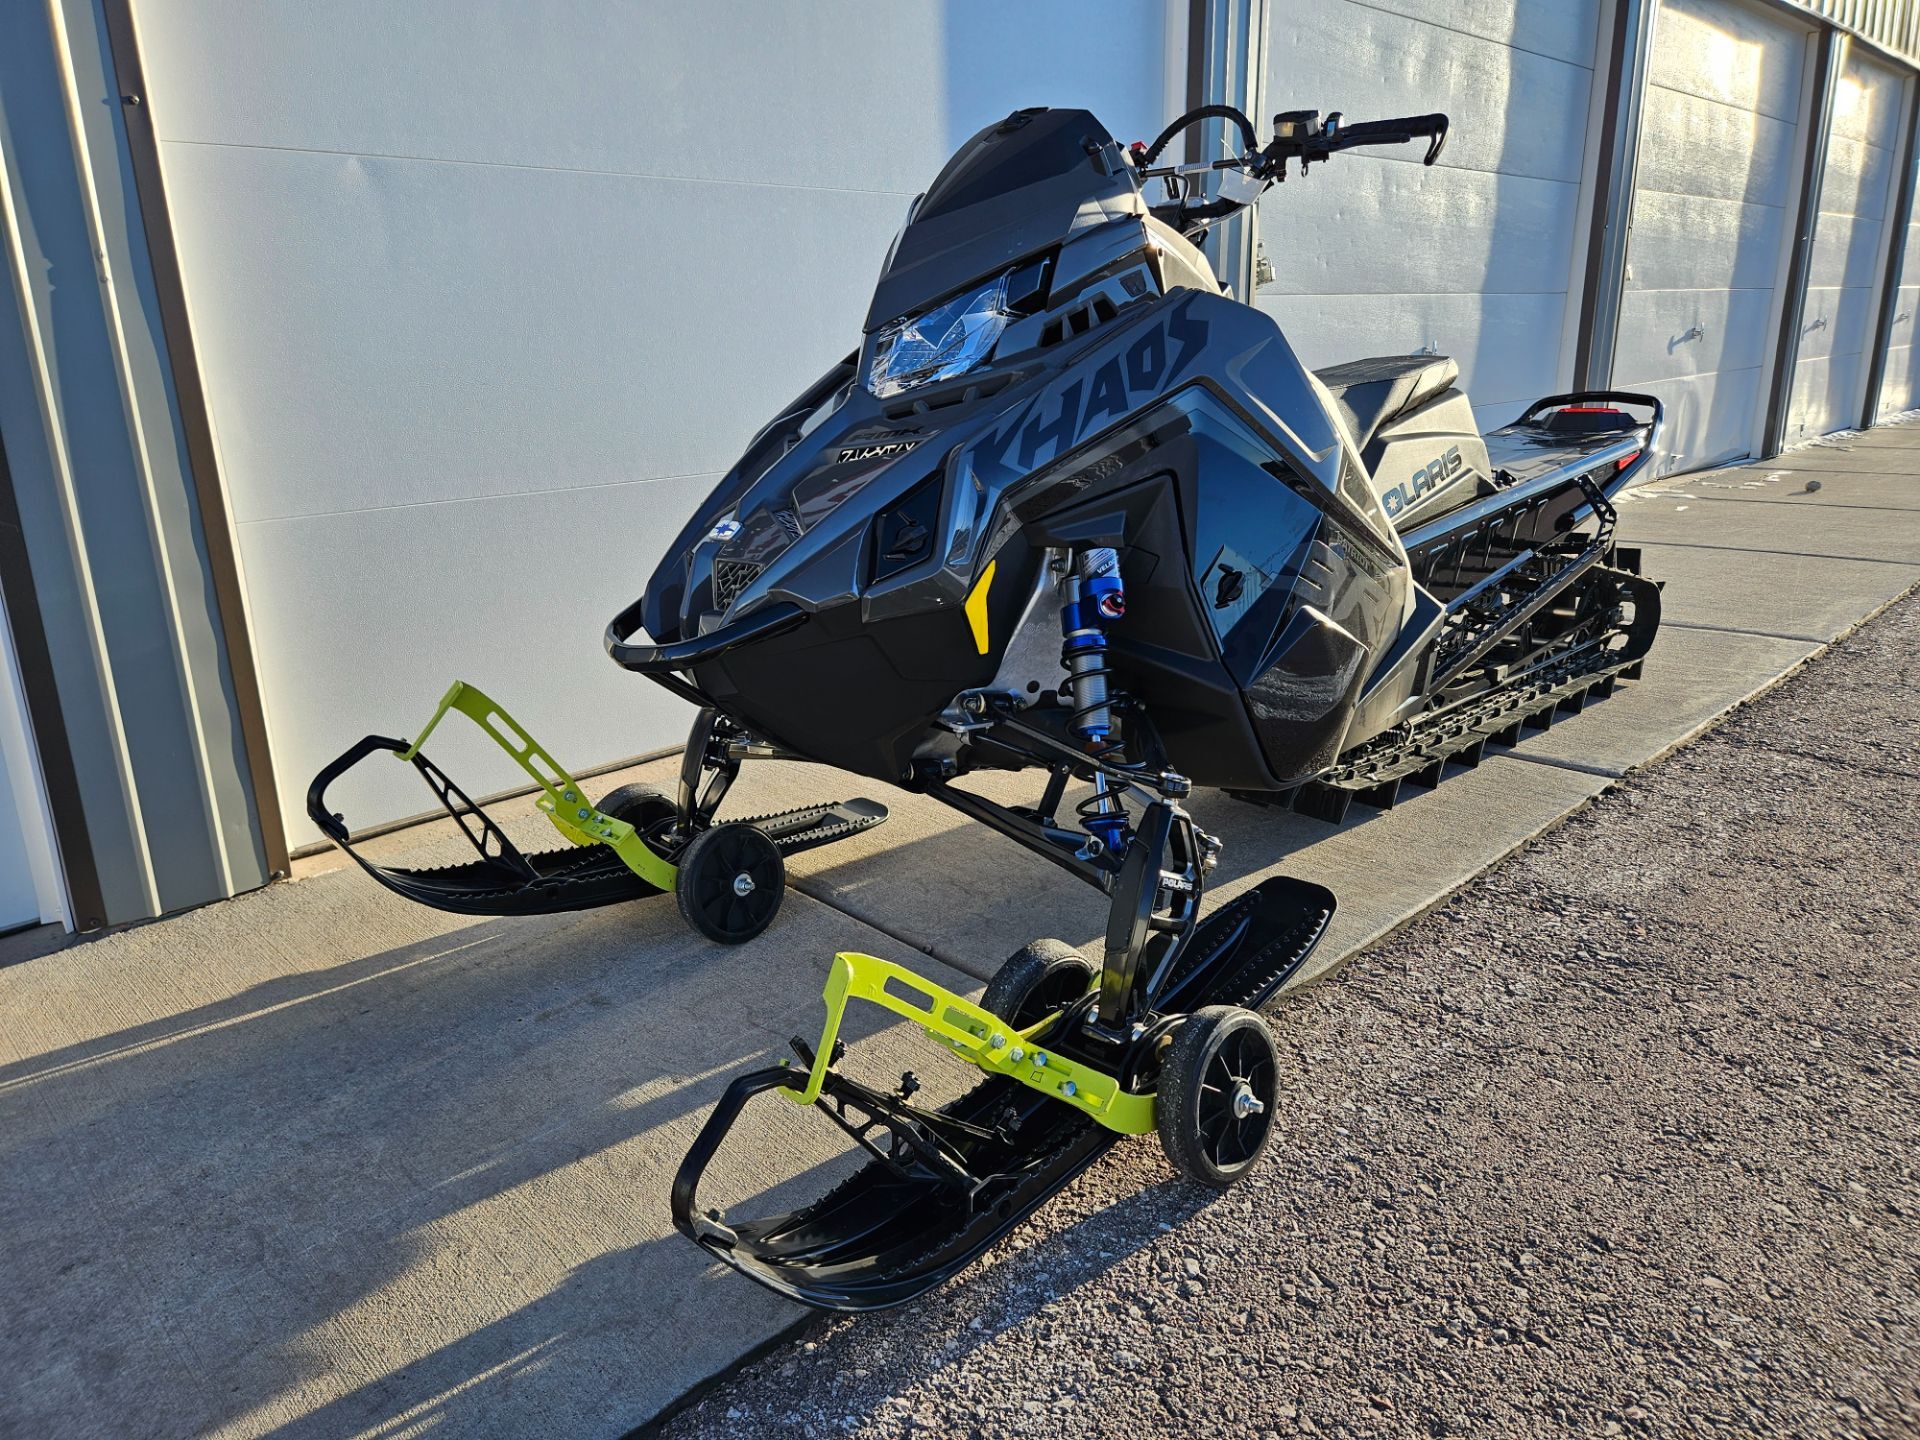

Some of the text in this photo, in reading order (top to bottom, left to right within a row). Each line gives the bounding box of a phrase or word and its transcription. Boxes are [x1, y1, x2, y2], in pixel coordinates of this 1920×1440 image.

[967, 289, 1210, 493] KHAOS
[1381, 445, 1462, 518] OLARIS
[1162, 877, 1192, 890] POLARIS
